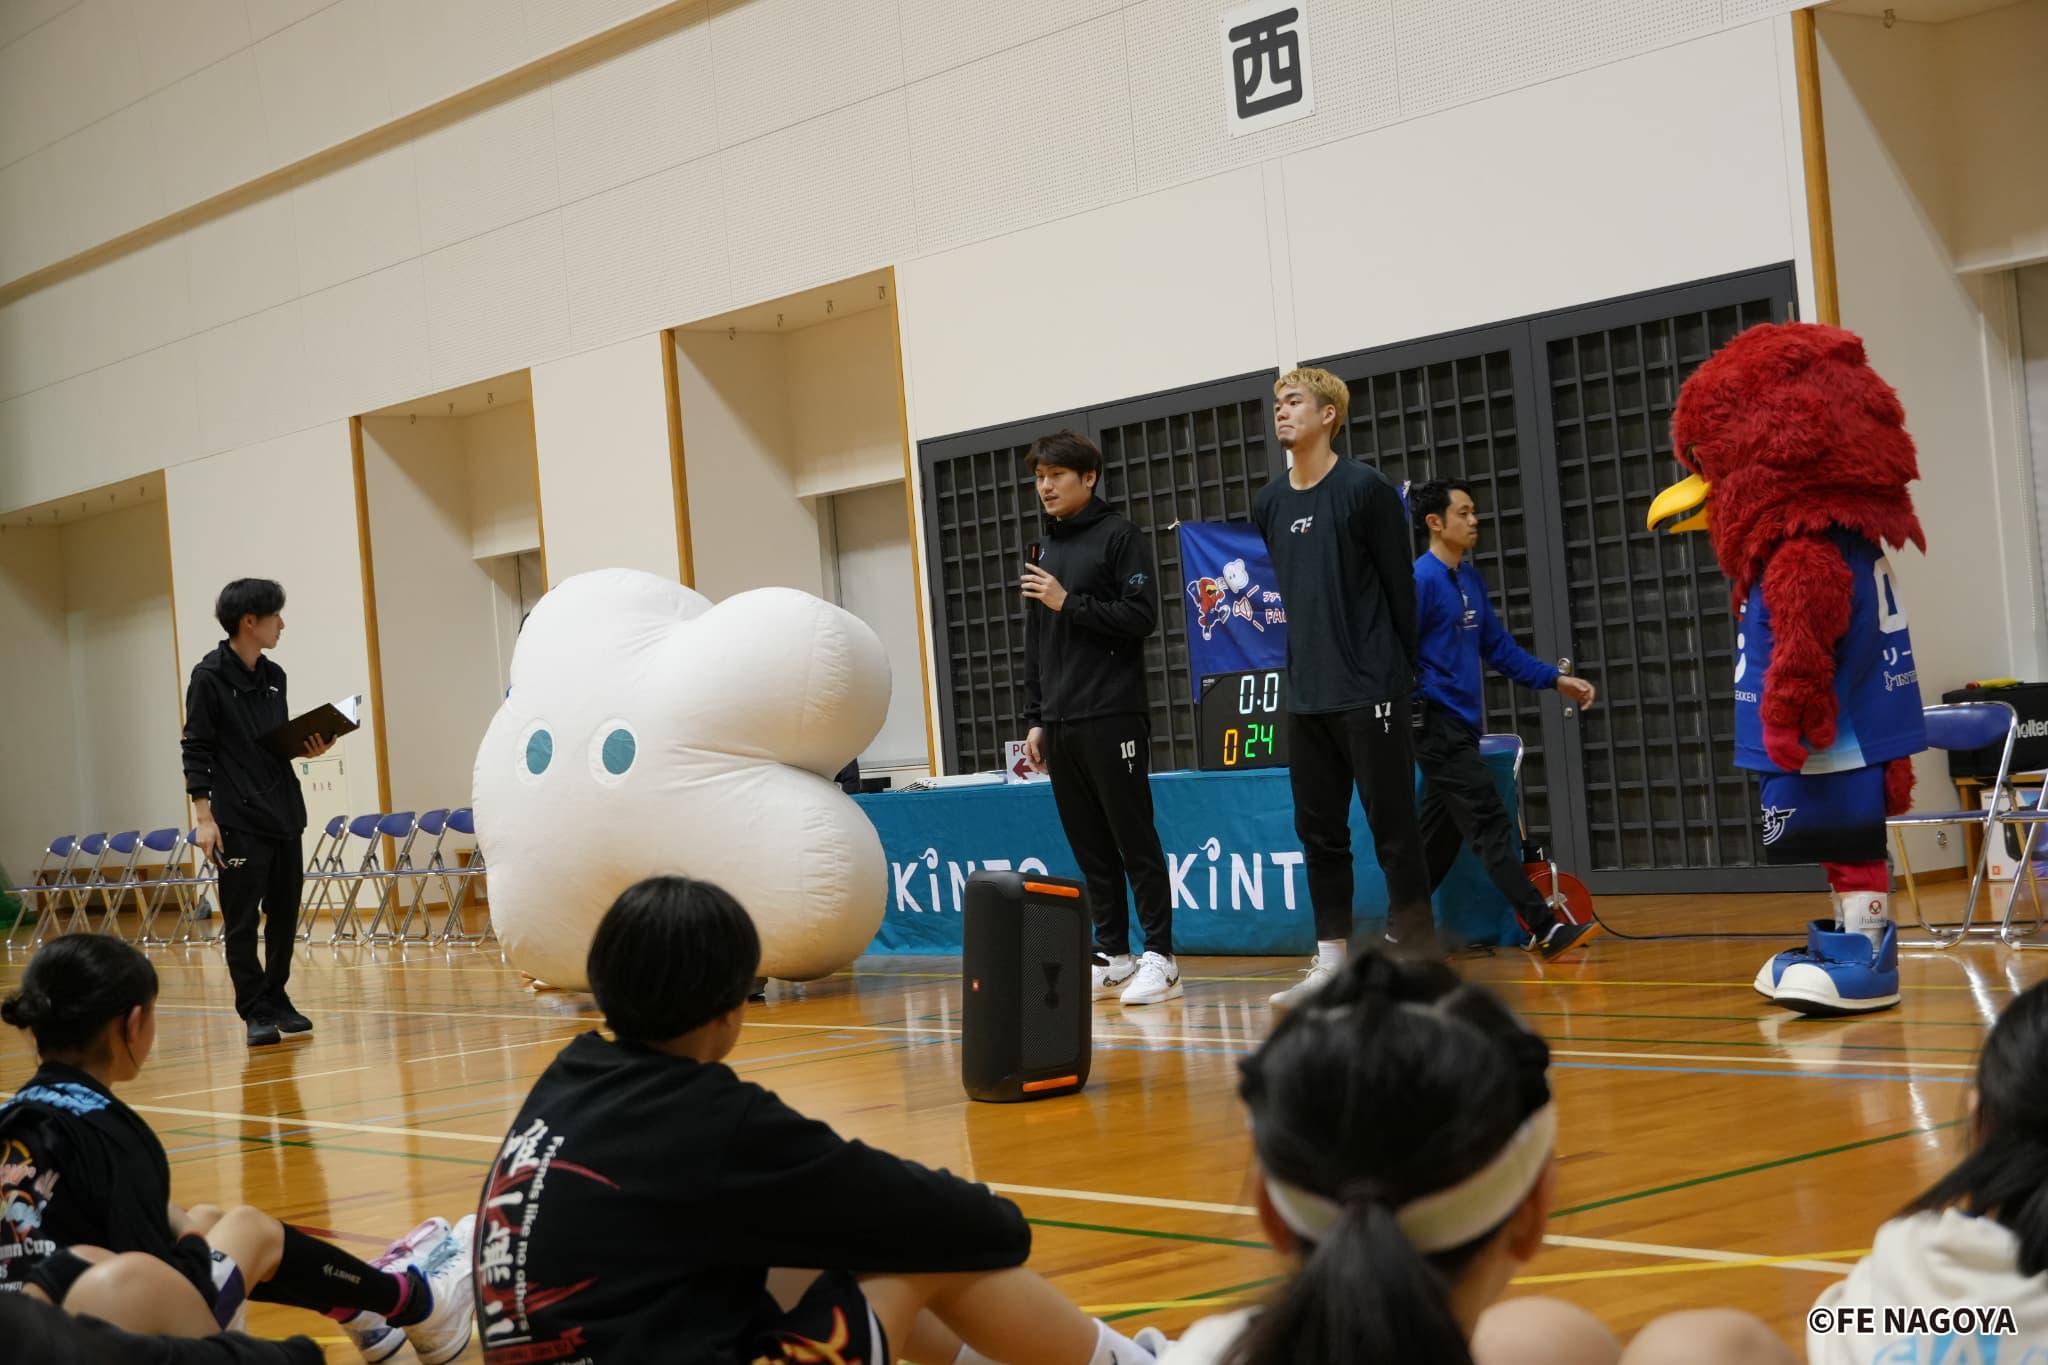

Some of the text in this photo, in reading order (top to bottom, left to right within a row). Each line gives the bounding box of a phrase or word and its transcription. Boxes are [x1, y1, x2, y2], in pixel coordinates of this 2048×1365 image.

[1229, 8, 1303, 119] 西
[1239, 672, 1279, 715] 0.0
[1120, 740, 1136, 759] 10
[1223, 728, 1239, 766] 0
[1244, 723, 1274, 758] 24
[24, 1236, 56, 1257] Cup
[514, 1135, 565, 1331] Friends like no others
